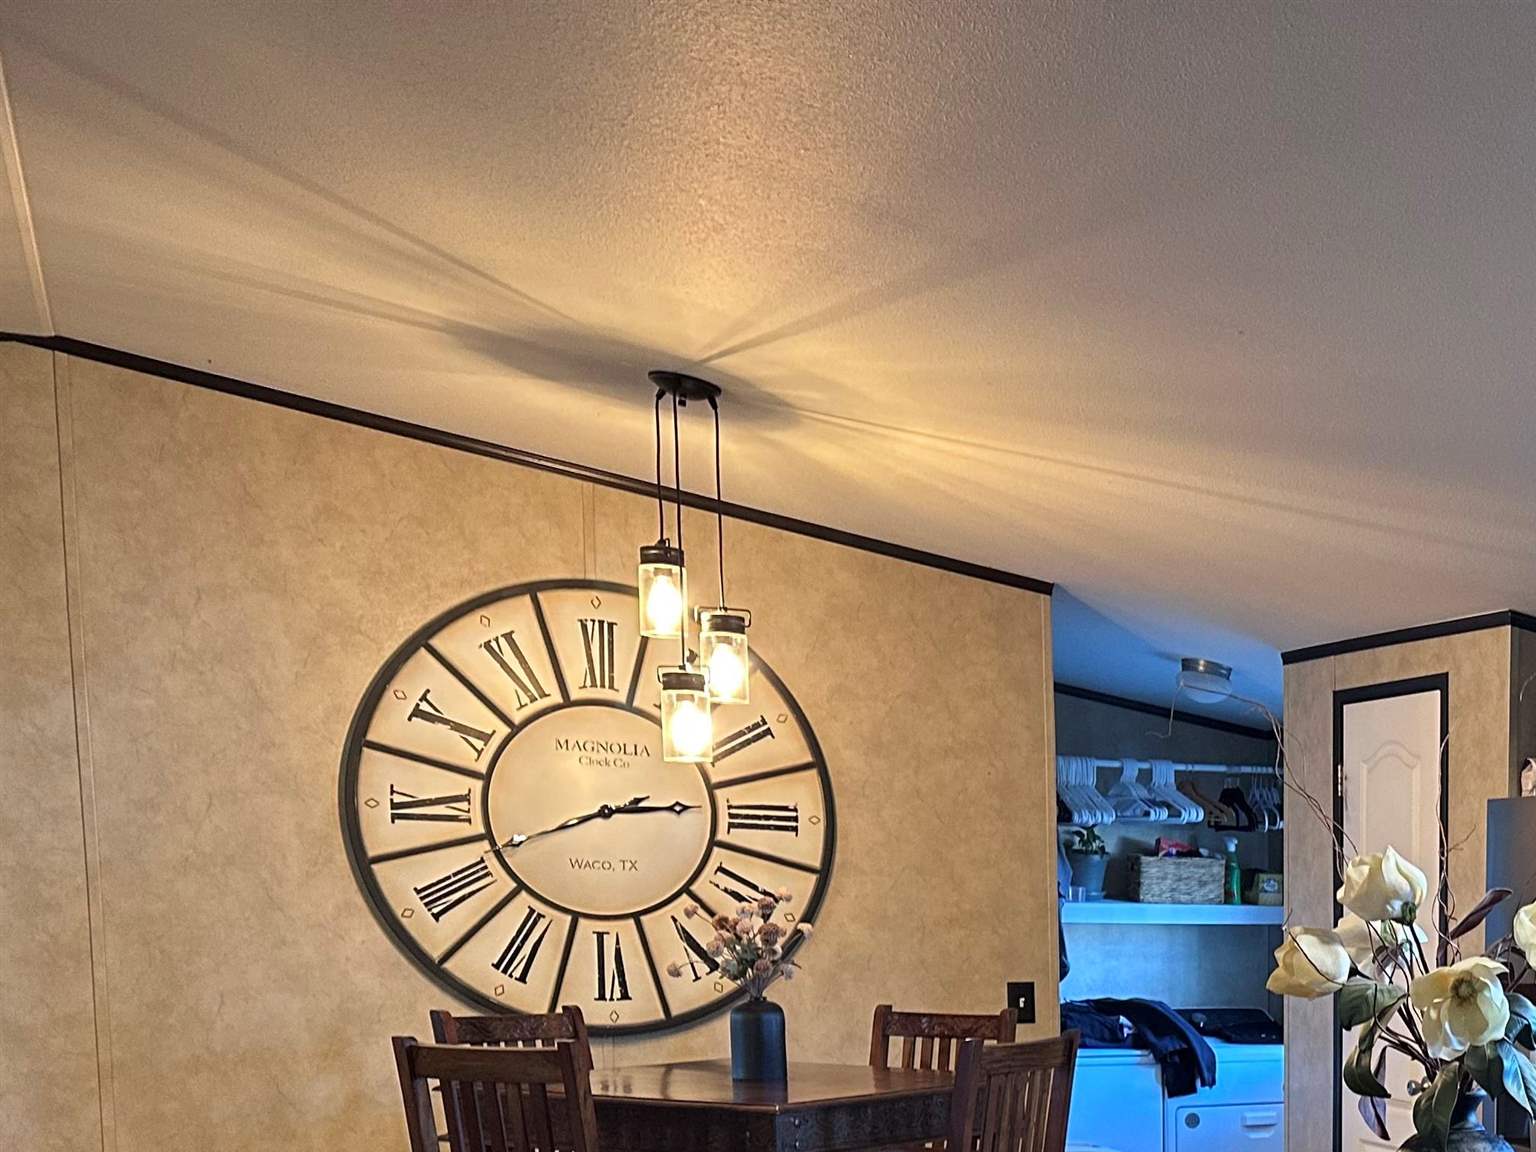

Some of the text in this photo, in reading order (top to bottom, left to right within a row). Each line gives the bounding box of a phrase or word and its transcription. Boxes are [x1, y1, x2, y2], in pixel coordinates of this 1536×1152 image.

[479, 629, 551, 712] XI
[578, 618, 619, 692] XII
[407, 688, 497, 763] X
[555, 737, 651, 758] MAGNOLIA
[578, 755, 630, 769] Clock Co
[389, 783, 472, 826] IX
[726, 798, 799, 838] III
[413, 856, 498, 923] VIII
[620, 859, 640, 872] TX
[491, 905, 553, 985] VII
[592, 930, 633, 1002] VI
